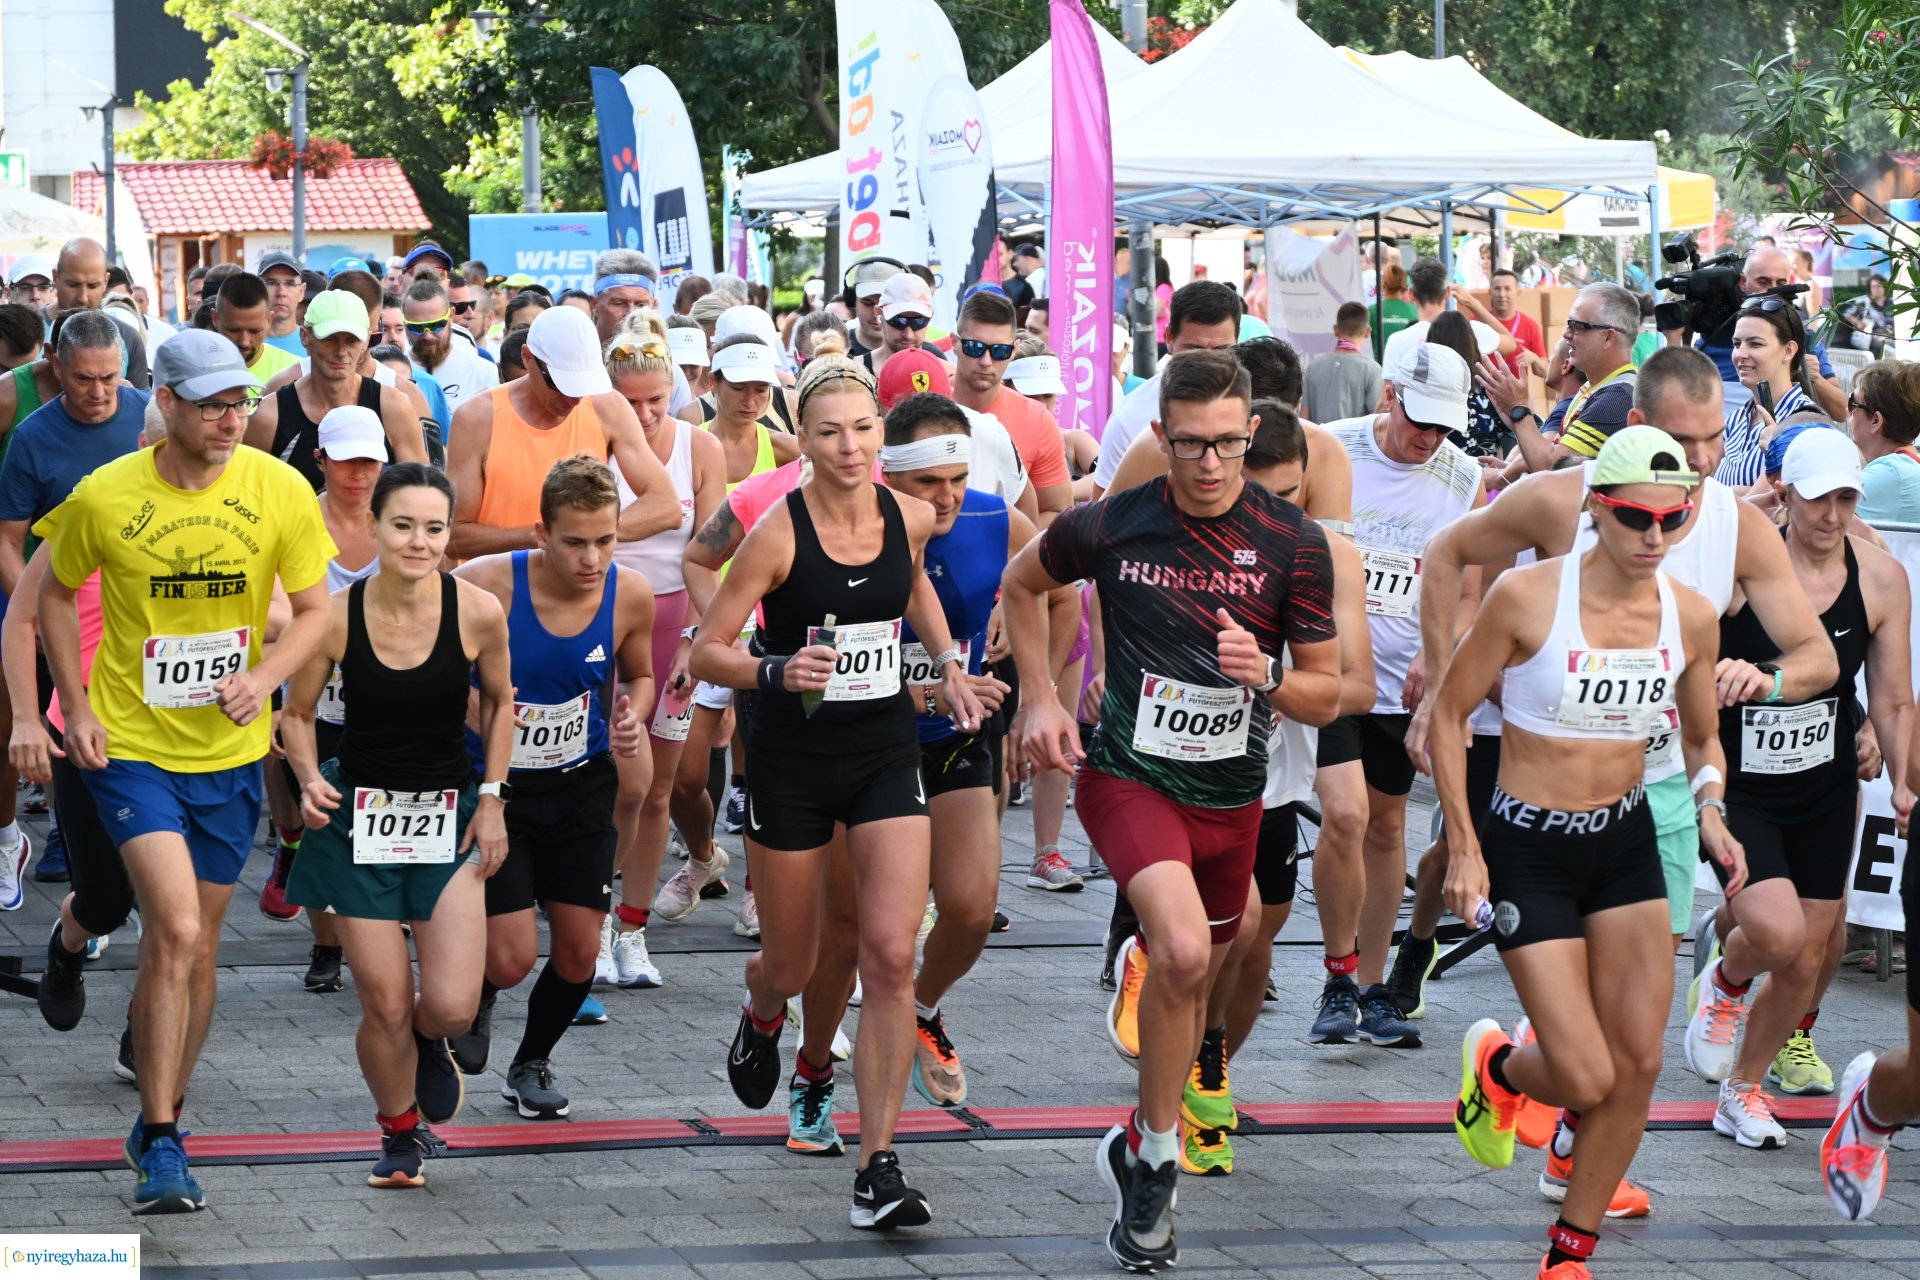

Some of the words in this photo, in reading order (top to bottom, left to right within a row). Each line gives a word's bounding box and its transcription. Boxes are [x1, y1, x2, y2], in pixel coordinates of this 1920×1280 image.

[516, 250, 605, 270] WHEY
[146, 516, 211, 547] MARATHON
[213, 516, 230, 530] DE
[230, 524, 260, 556] PARIS
[214, 559, 231, 567] AVRIL
[232, 558, 246, 567] 2012
[150, 579, 247, 599] FINISHER
[1118, 559, 1268, 595] HUNGARY
[187, 643, 233, 653] FUTÓFESZTIVÁL
[156, 652, 242, 684] 10159
[1188, 698, 1237, 707] FUTÓFESZTIVÁL
[1578, 677, 1667, 704] 10118
[520, 715, 585, 747] 10103
[1153, 704, 1244, 736] 10089
[1755, 721, 1830, 751] 10150
[366, 813, 446, 837] 10121
[1540, 807, 1611, 835] PRO
[1560, 1232, 1580, 1250] 742
